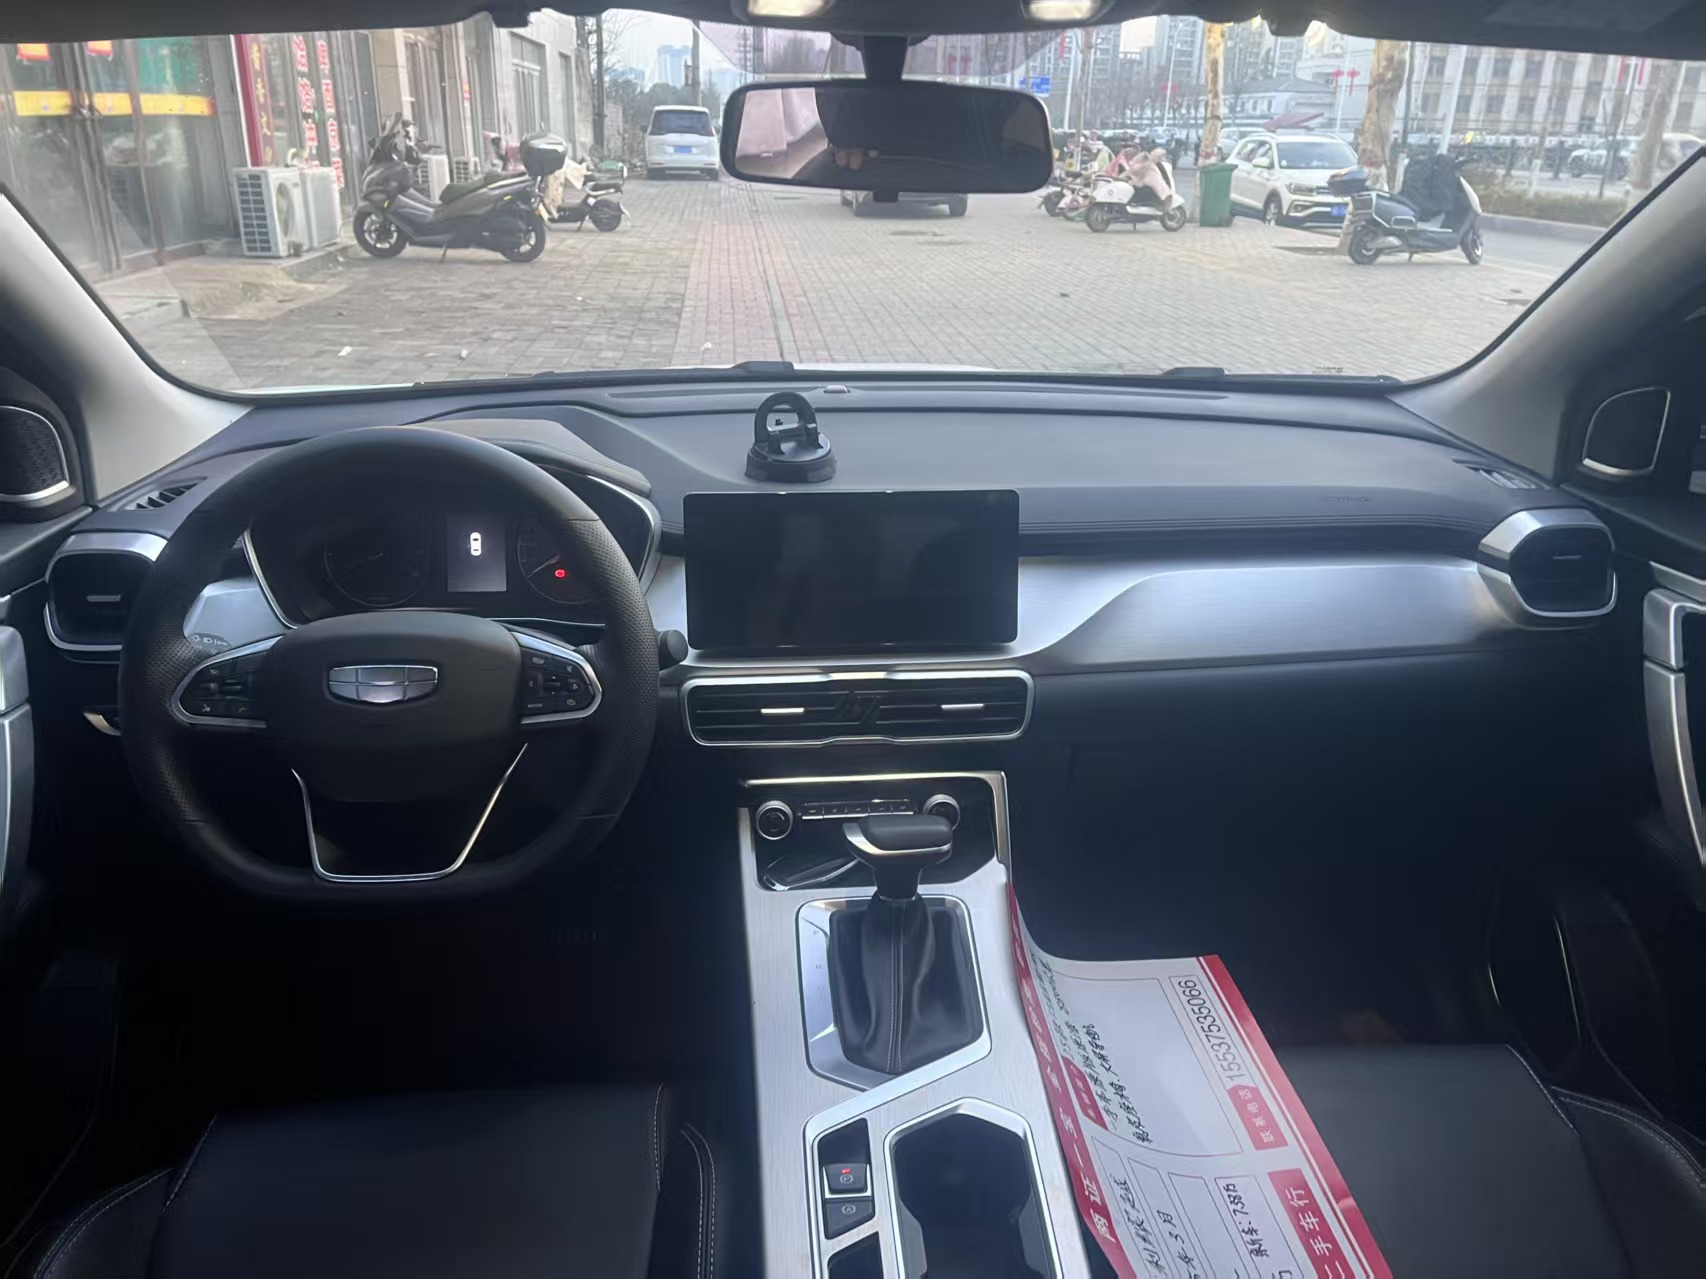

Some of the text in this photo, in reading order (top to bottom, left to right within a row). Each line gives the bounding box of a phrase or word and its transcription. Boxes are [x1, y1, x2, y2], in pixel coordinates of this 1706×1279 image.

[1178, 979, 1246, 1081] 15537535066
[1237, 1088, 1275, 1144] 联系电话
[1285, 1187, 1346, 1279] 二手车行
